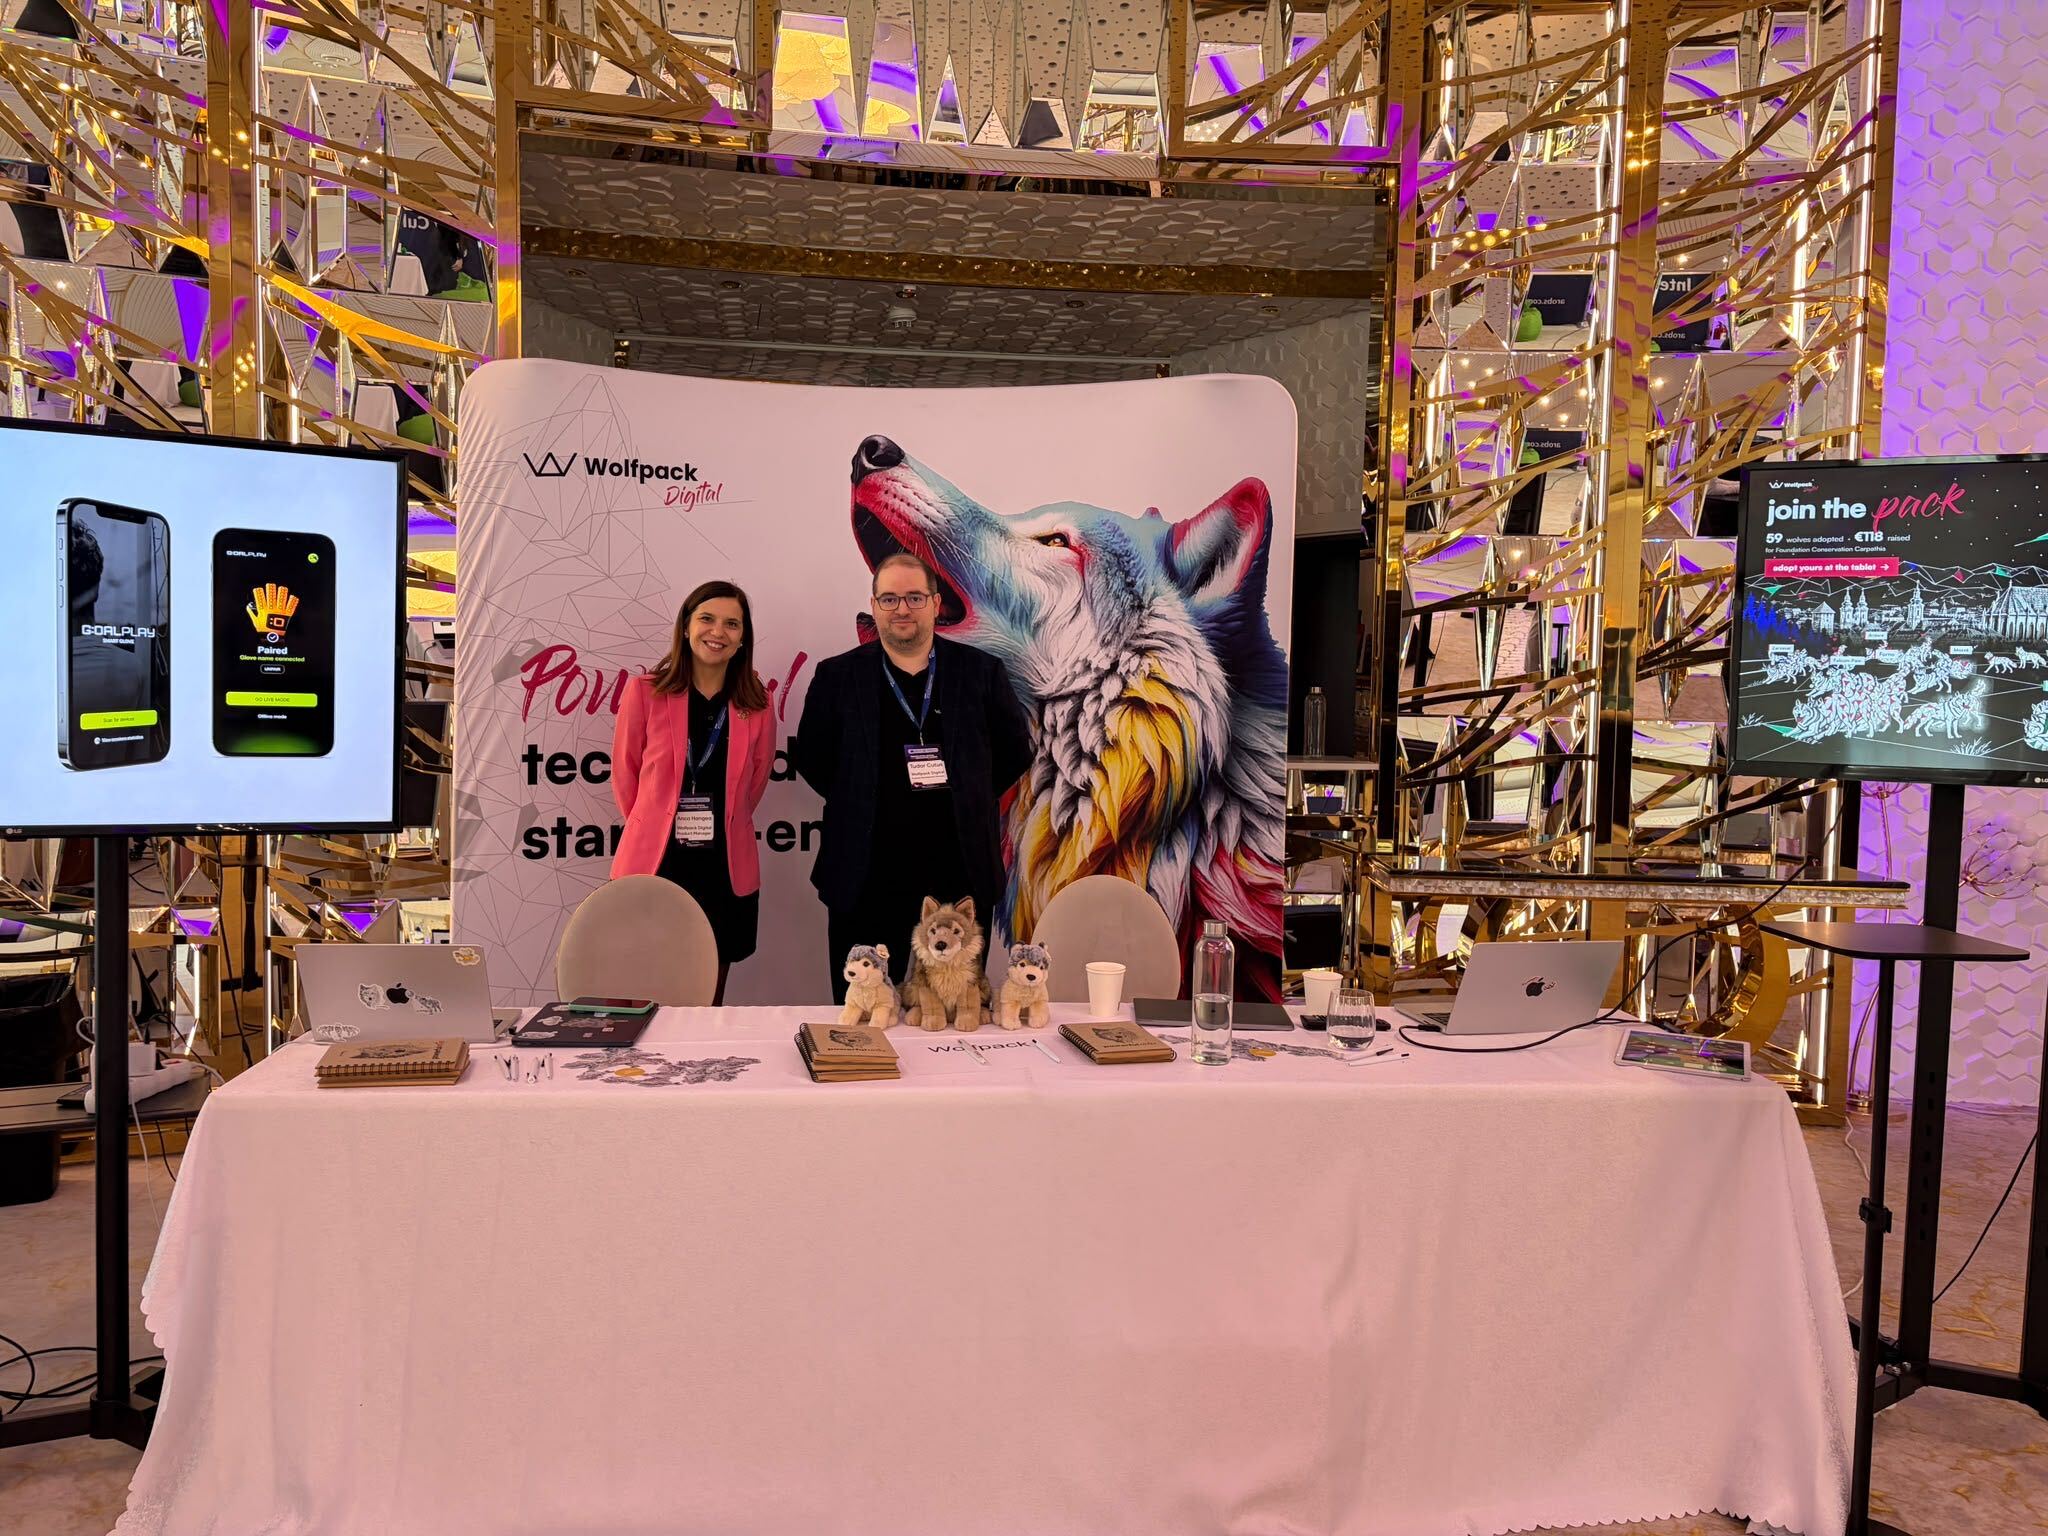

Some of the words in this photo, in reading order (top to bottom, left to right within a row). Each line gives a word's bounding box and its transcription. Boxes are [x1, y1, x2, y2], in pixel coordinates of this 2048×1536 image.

[584, 457, 698, 484] Wolfpack
[664, 481, 723, 512] Digital
[1766, 498, 1816, 527] join
[1822, 497, 1867, 519] the
[1871, 483, 1967, 532] pack
[1765, 533, 1783, 544] 59
[1812, 535, 1844, 545] adopted
[1854, 531, 1884, 542] €118
[1887, 534, 1911, 542] raised
[1772, 563, 1798, 574] adopt
[1799, 565, 1823, 574] yours
[1834, 563, 1849, 571] the
[1850, 563, 1877, 571] tablet
[257, 645, 288, 655] Paired
[275, 655, 305, 663] connected
